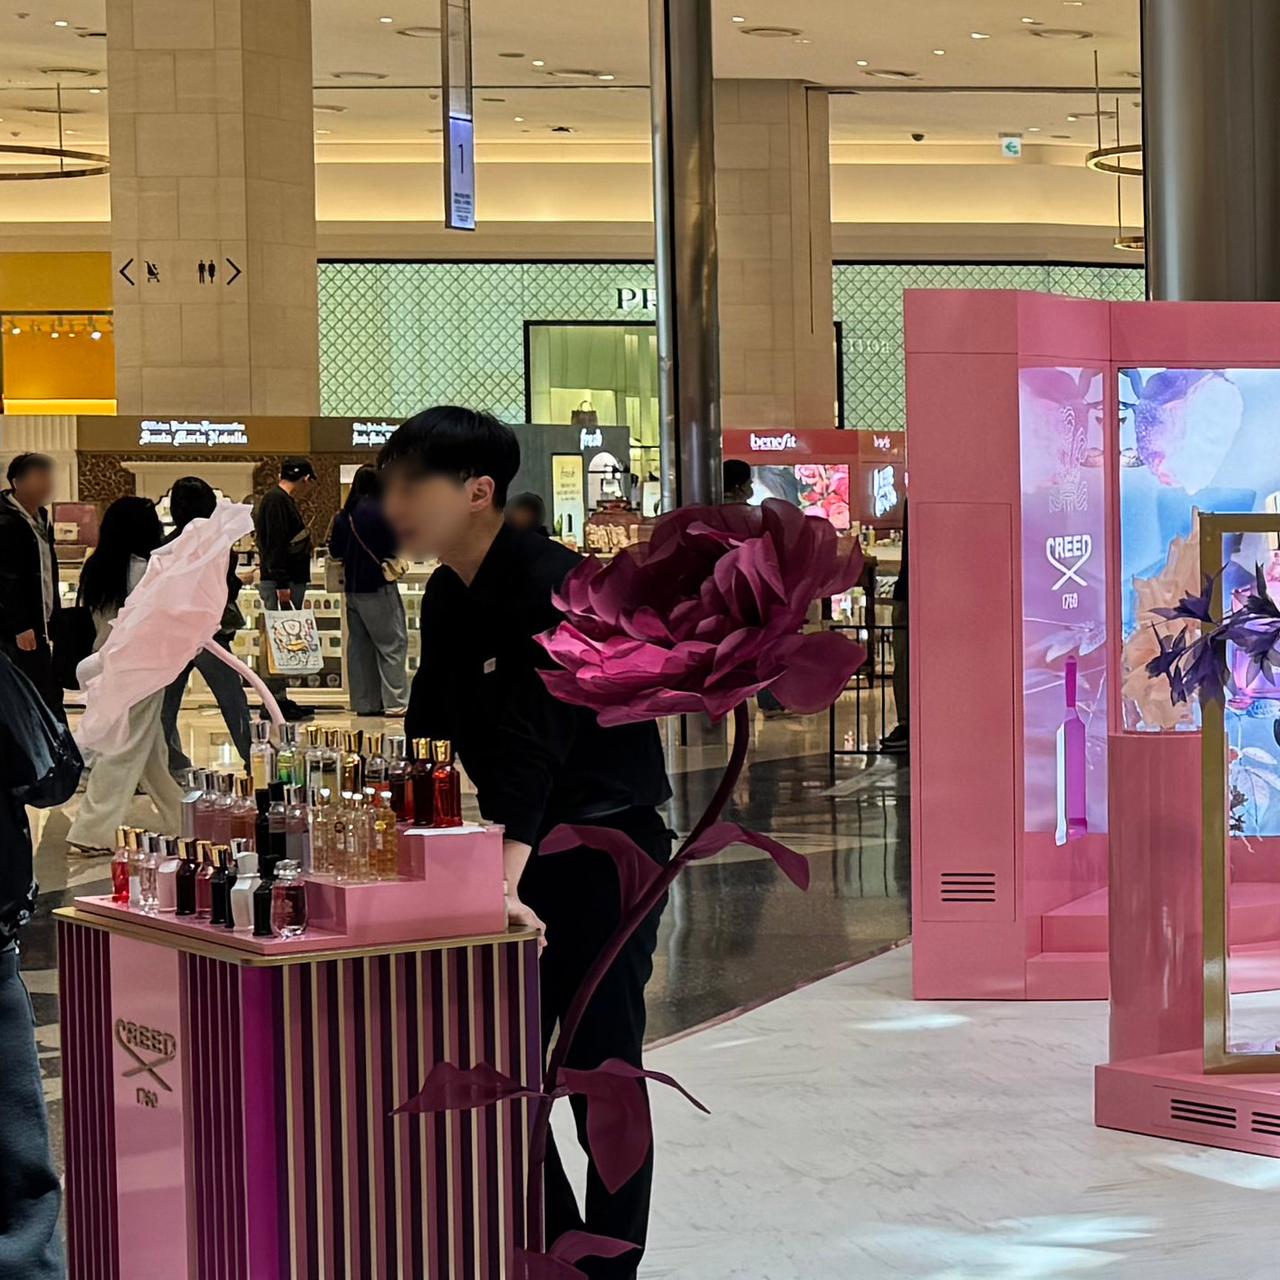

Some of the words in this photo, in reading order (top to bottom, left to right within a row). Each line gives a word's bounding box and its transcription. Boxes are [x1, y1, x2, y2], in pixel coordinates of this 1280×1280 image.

[458, 144, 464, 174] 1
[750, 432, 797, 450] benefit
[1046, 535, 1091, 573] CREED
[115, 1018, 176, 1069] CREED
